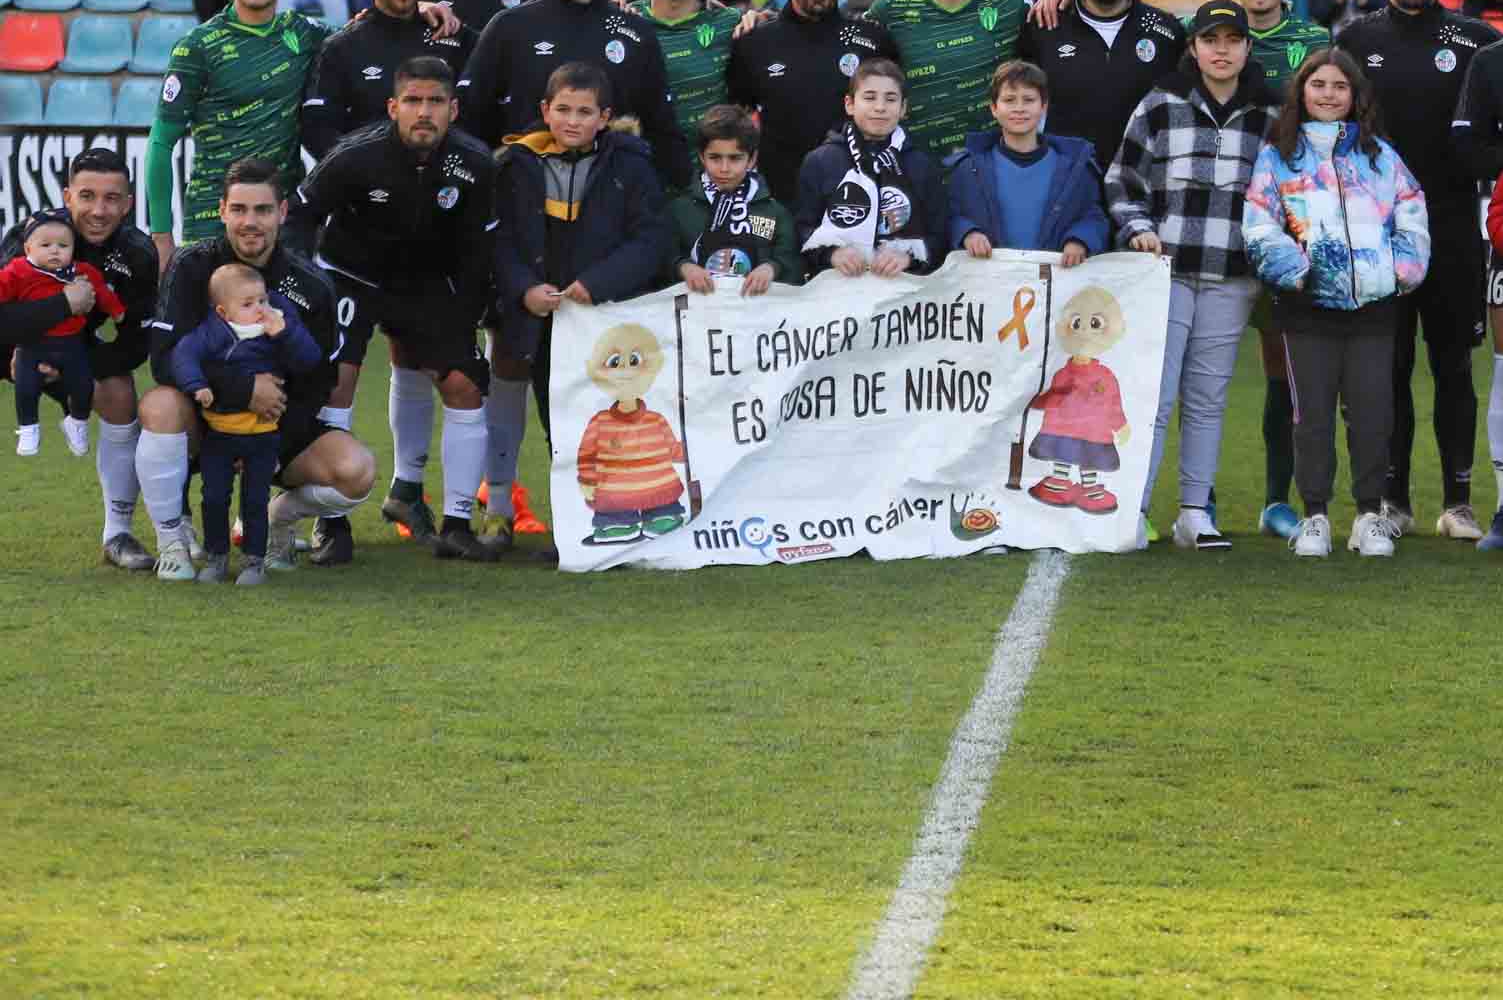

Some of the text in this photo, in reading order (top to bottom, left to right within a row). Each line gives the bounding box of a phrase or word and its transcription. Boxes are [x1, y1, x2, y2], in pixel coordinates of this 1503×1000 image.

[338, 296, 355, 328] 0
[707, 291, 985, 376] EL CÁNCER TAMBIÉN
[731, 397, 768, 445] ES
[853, 370, 888, 418] DE
[904, 358, 992, 414] NIÑOS
[799, 515, 855, 541] con
